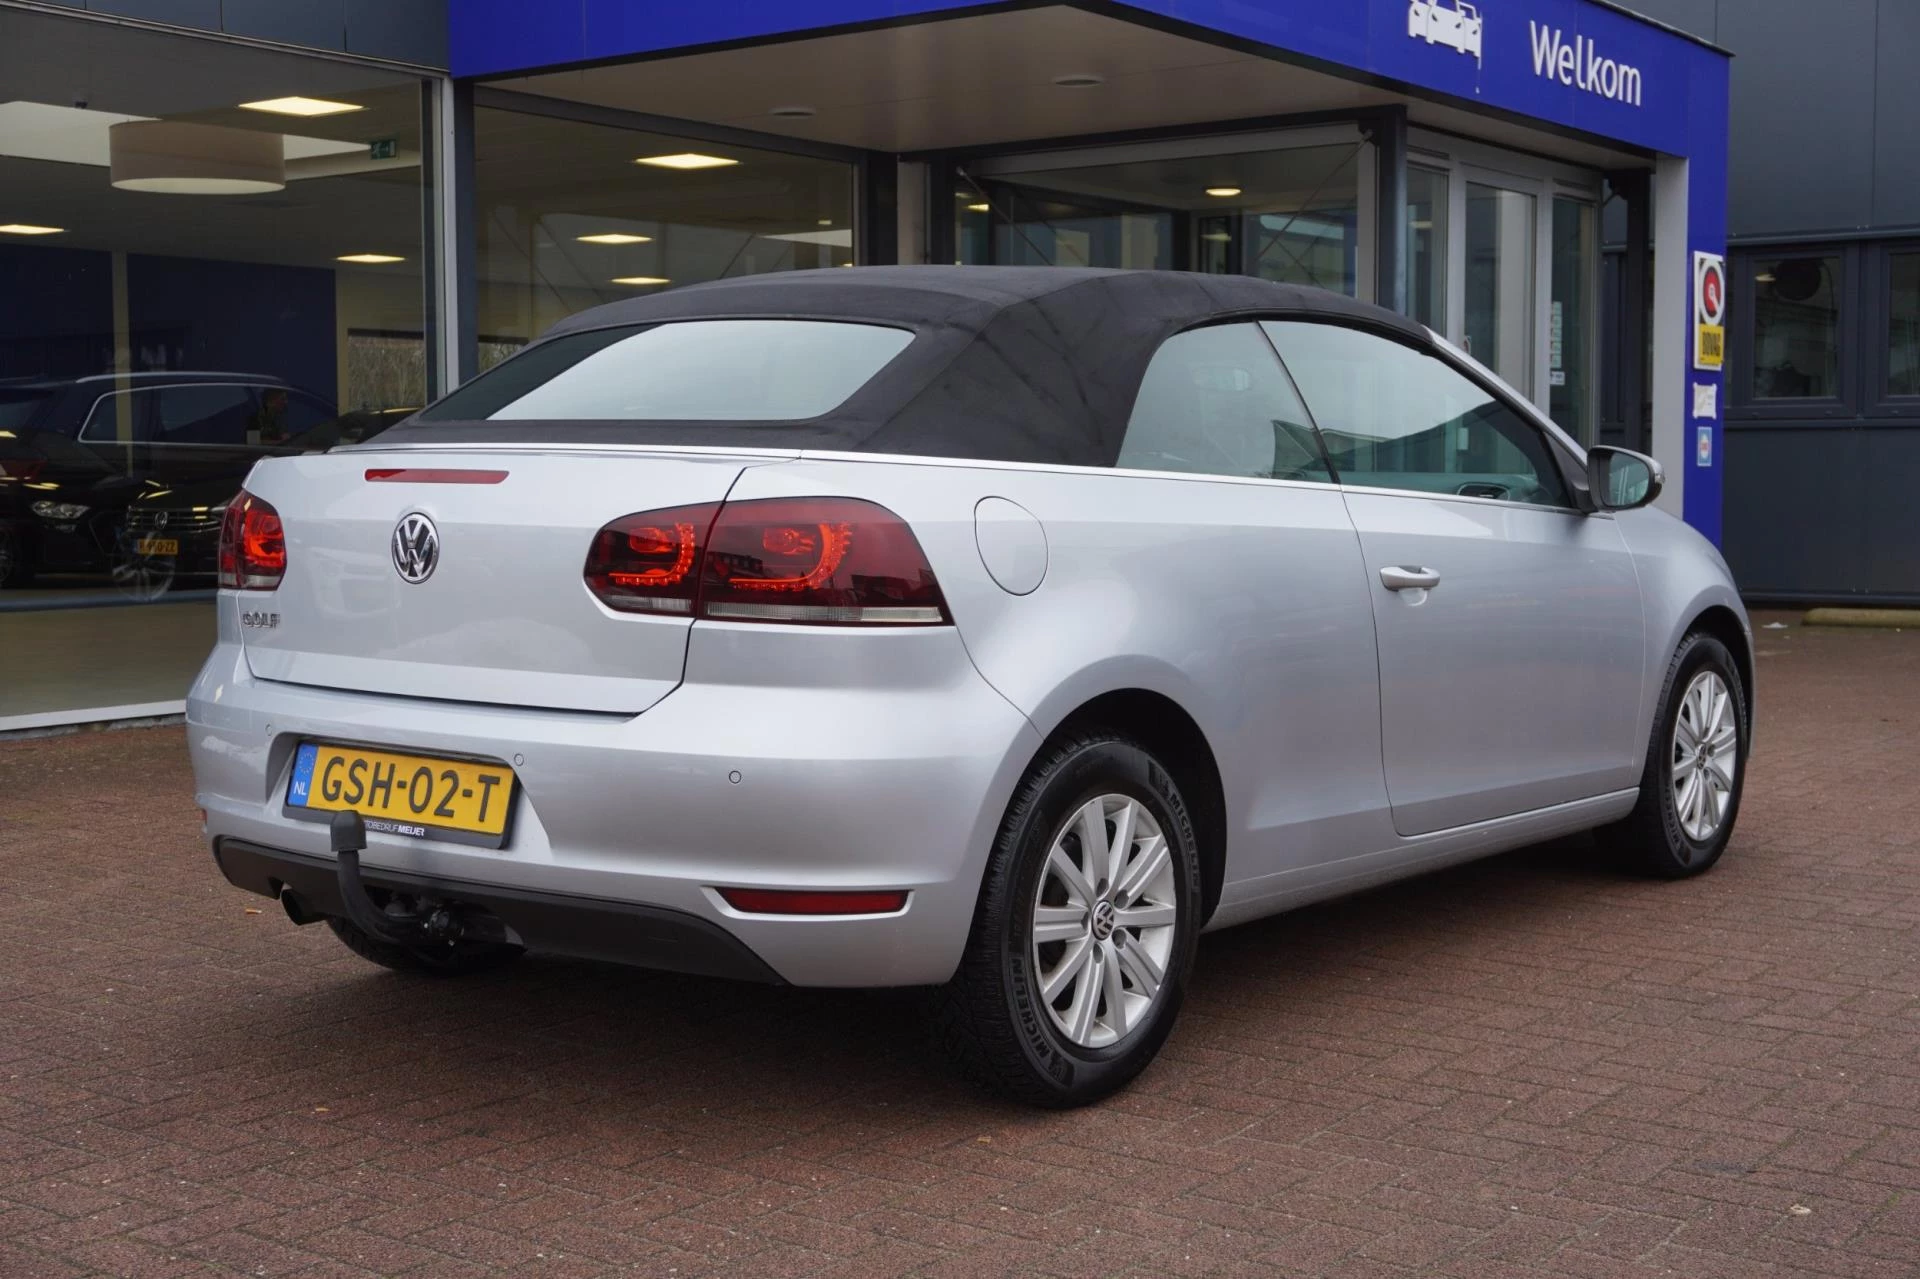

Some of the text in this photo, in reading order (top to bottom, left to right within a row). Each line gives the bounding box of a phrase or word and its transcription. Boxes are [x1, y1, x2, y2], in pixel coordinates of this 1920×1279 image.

[1530, 19, 1642, 107] Welkom
[242, 611, 280, 629] GOLF
[293, 781, 307, 796] NL
[321, 755, 501, 823] GSH-02-T
[1011, 957, 1051, 1059] MICHELIN
